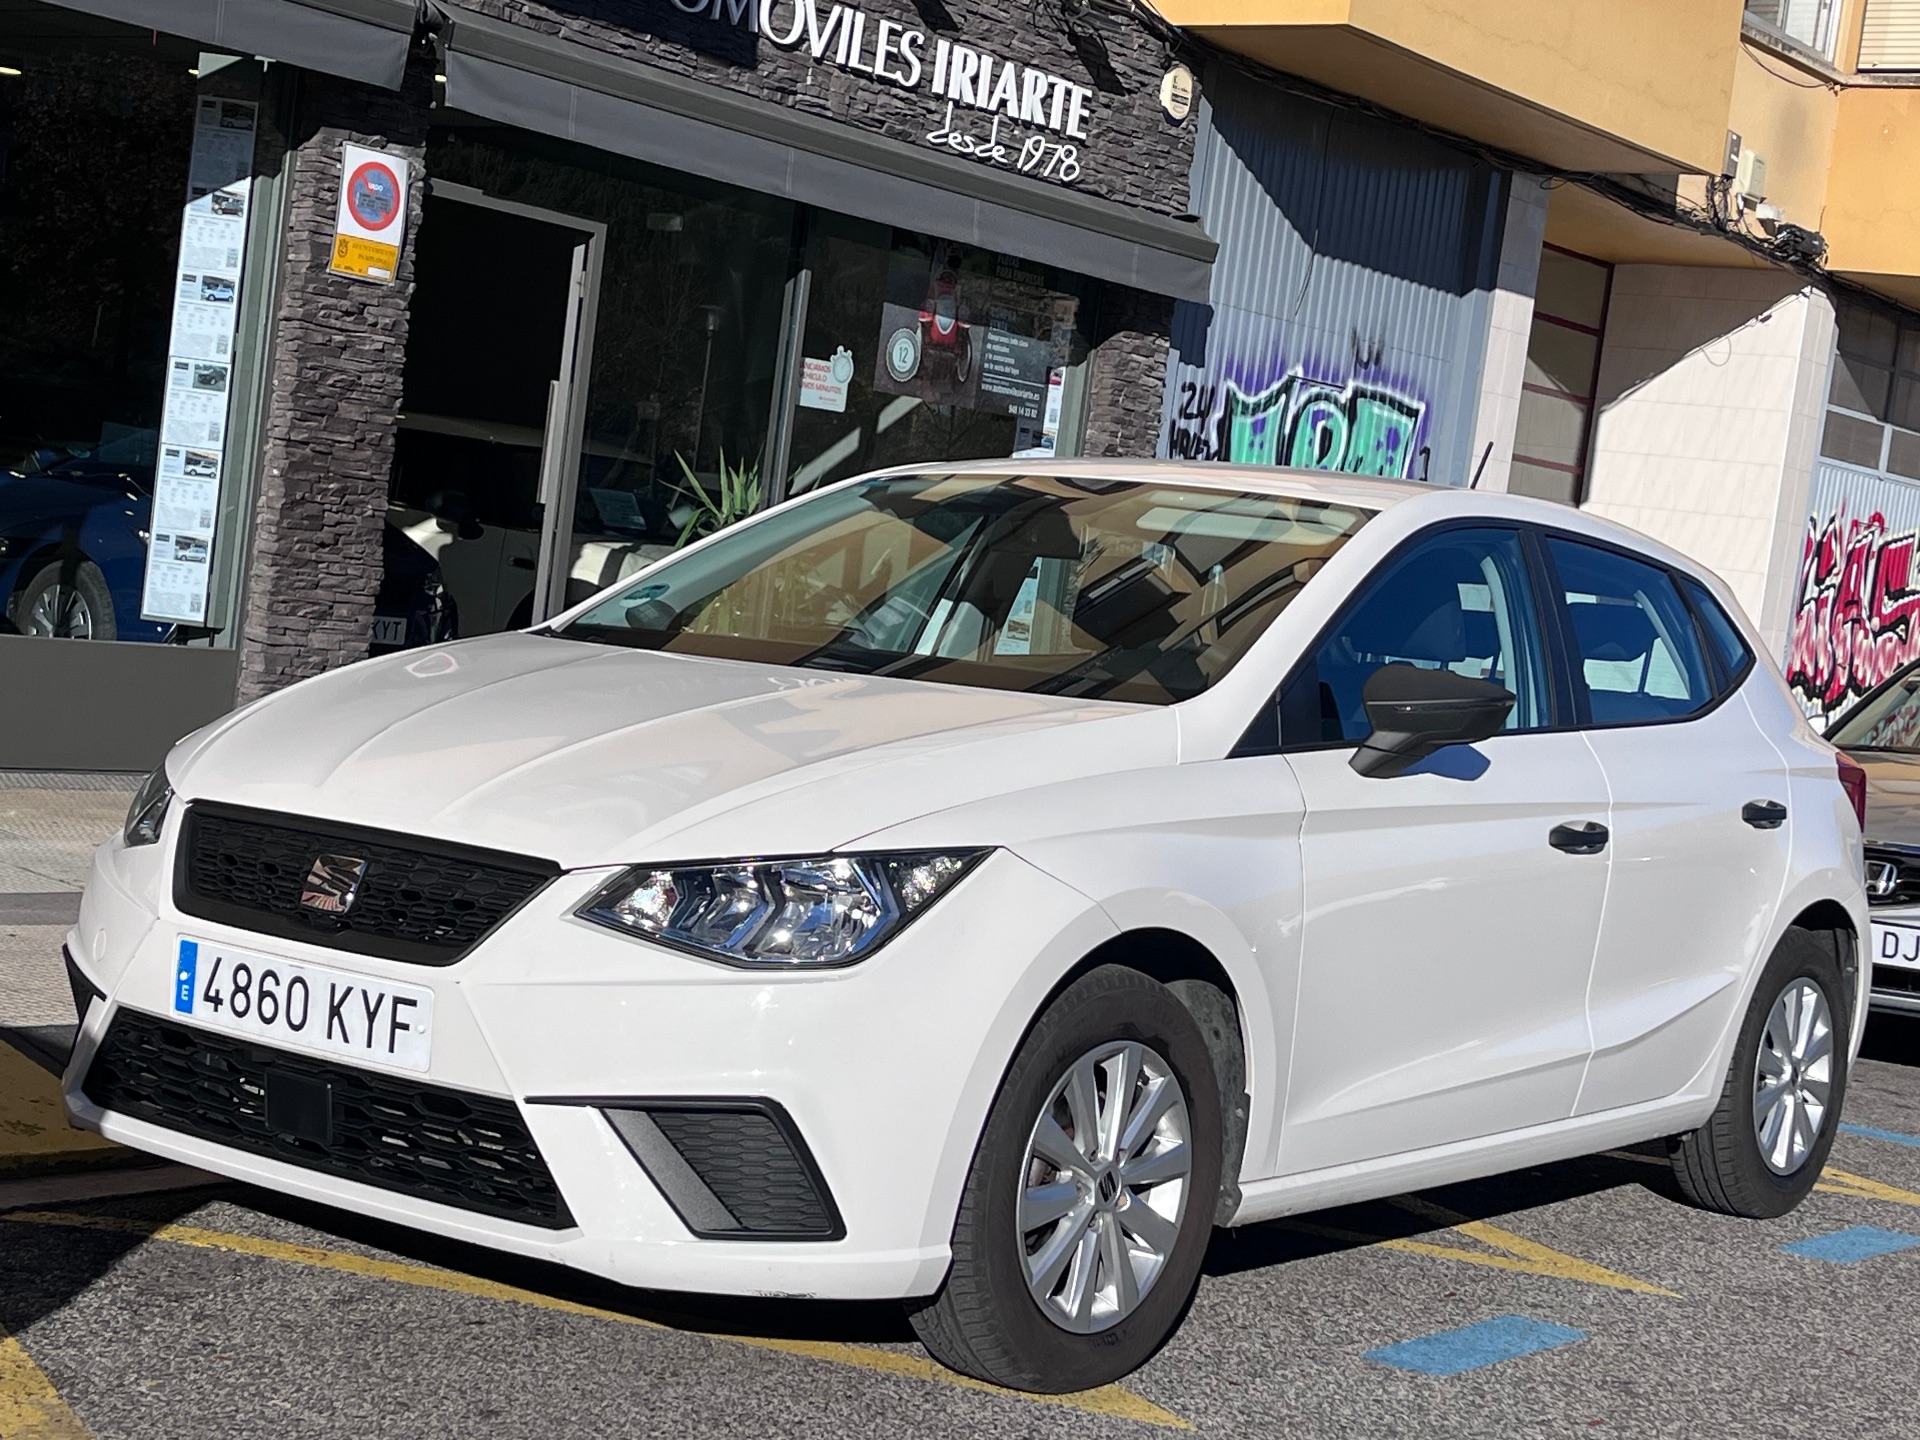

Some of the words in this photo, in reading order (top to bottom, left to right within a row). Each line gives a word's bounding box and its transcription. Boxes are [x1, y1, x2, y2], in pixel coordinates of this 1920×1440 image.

[671, 0, 925, 87] OVILES
[932, 39, 1093, 140] IRIARTE
[926, 101, 1009, 163] desde
[1017, 136, 1080, 181] 1978
[899, 346, 909, 364] 12
[180, 984, 190, 1001] E
[202, 956, 309, 1032] 4860
[326, 982, 418, 1053] KYF
